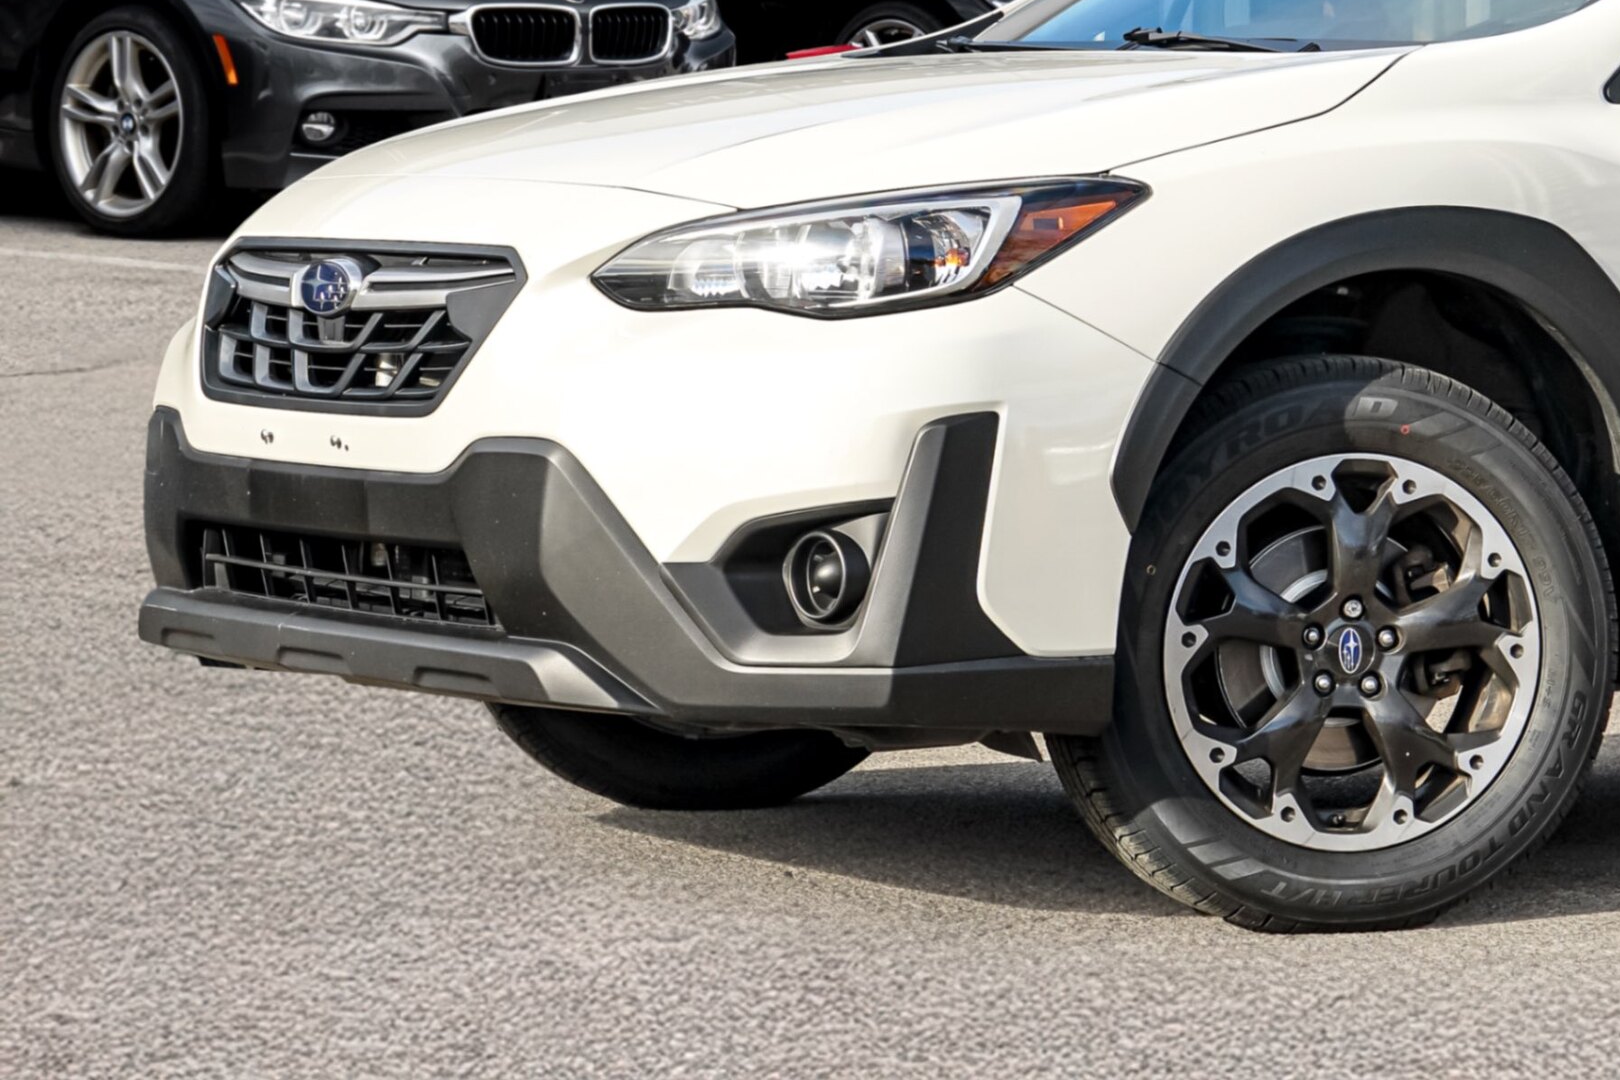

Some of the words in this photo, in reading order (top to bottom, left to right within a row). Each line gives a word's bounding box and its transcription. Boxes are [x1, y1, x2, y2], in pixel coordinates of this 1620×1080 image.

[1501, 689, 1590, 840] GRAND
[1259, 871, 1343, 911] H/T
[1343, 832, 1508, 907] TOURER
